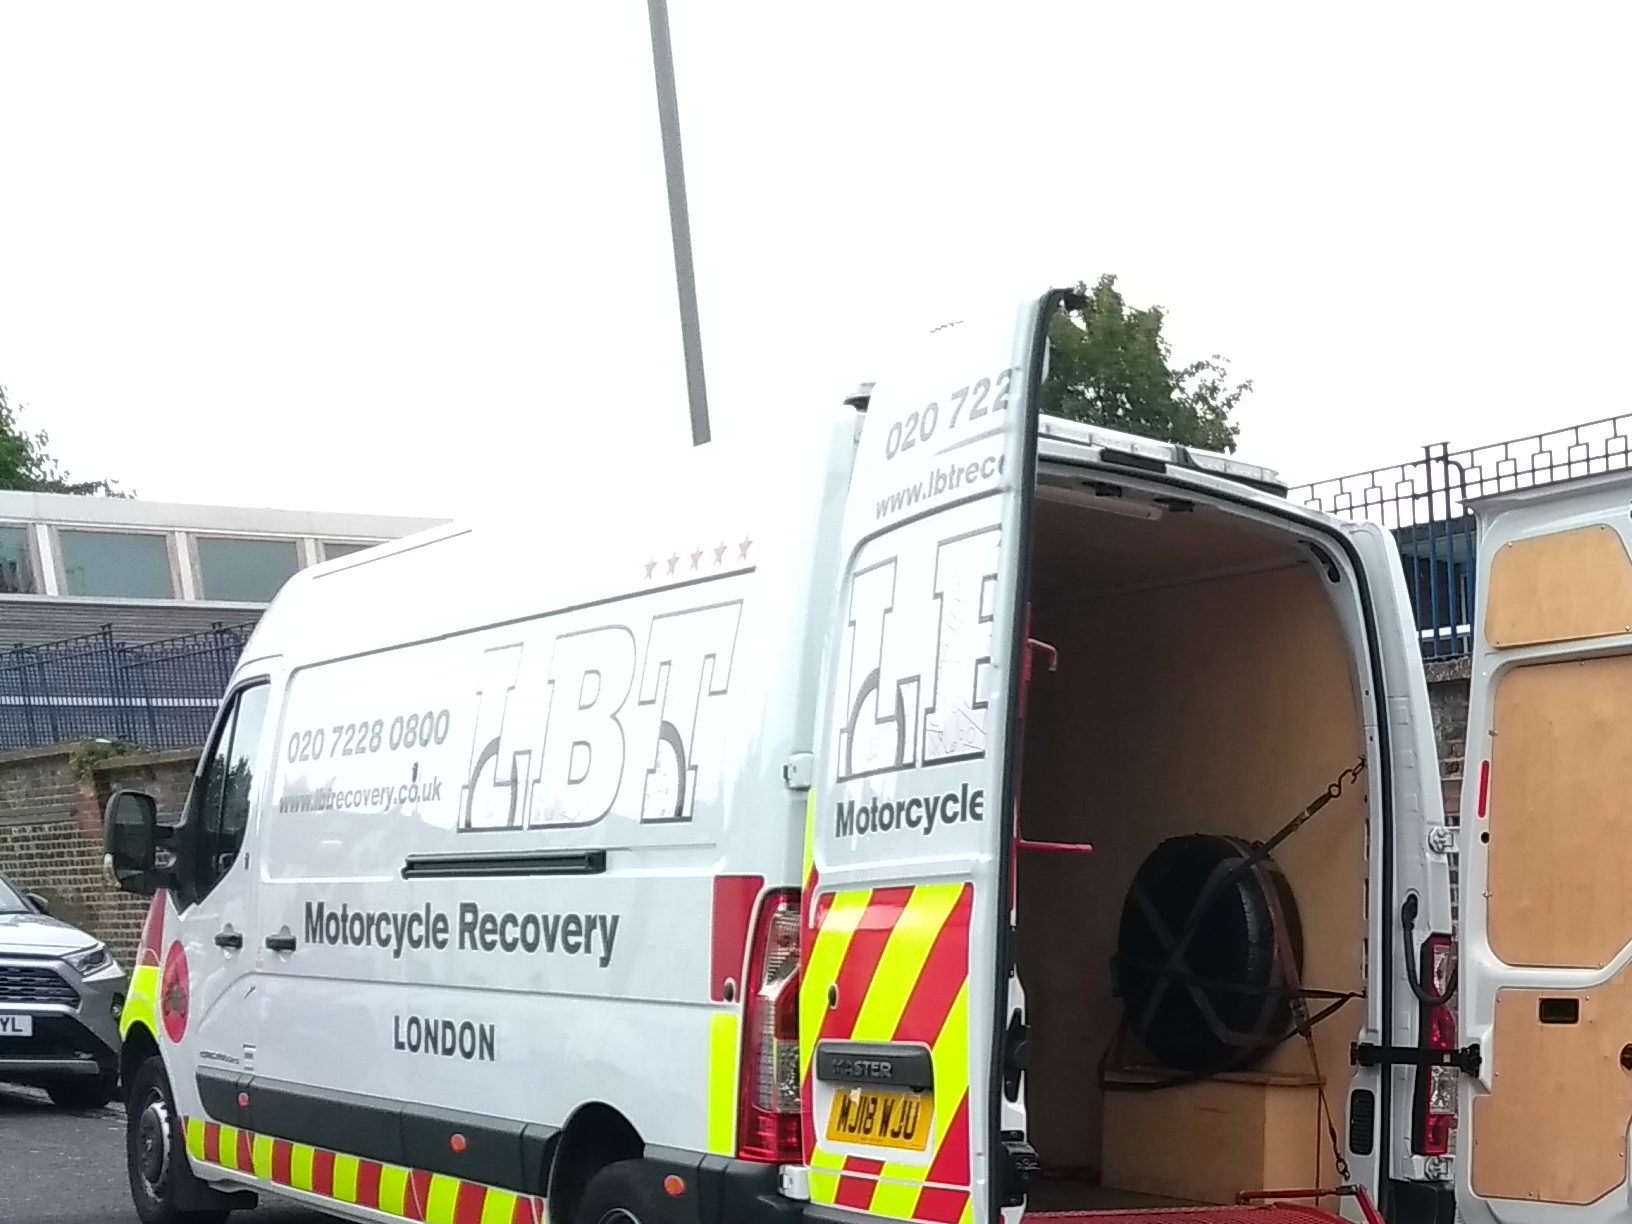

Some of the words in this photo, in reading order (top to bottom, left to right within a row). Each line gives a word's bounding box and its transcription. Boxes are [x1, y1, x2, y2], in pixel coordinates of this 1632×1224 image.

[885, 402, 939, 460] 020
[287, 728, 325, 763] 020
[330, 719, 384, 757] 7228
[389, 709, 450, 751] 0800
[456, 599, 743, 832] LBT
[835, 782, 984, 838] Motorcycle
[304, 901, 450, 959] Motorcycle
[458, 901, 620, 968] Recovery
[394, 1015, 495, 1062] LONDON
[833, 1059, 893, 1078] MASTER
